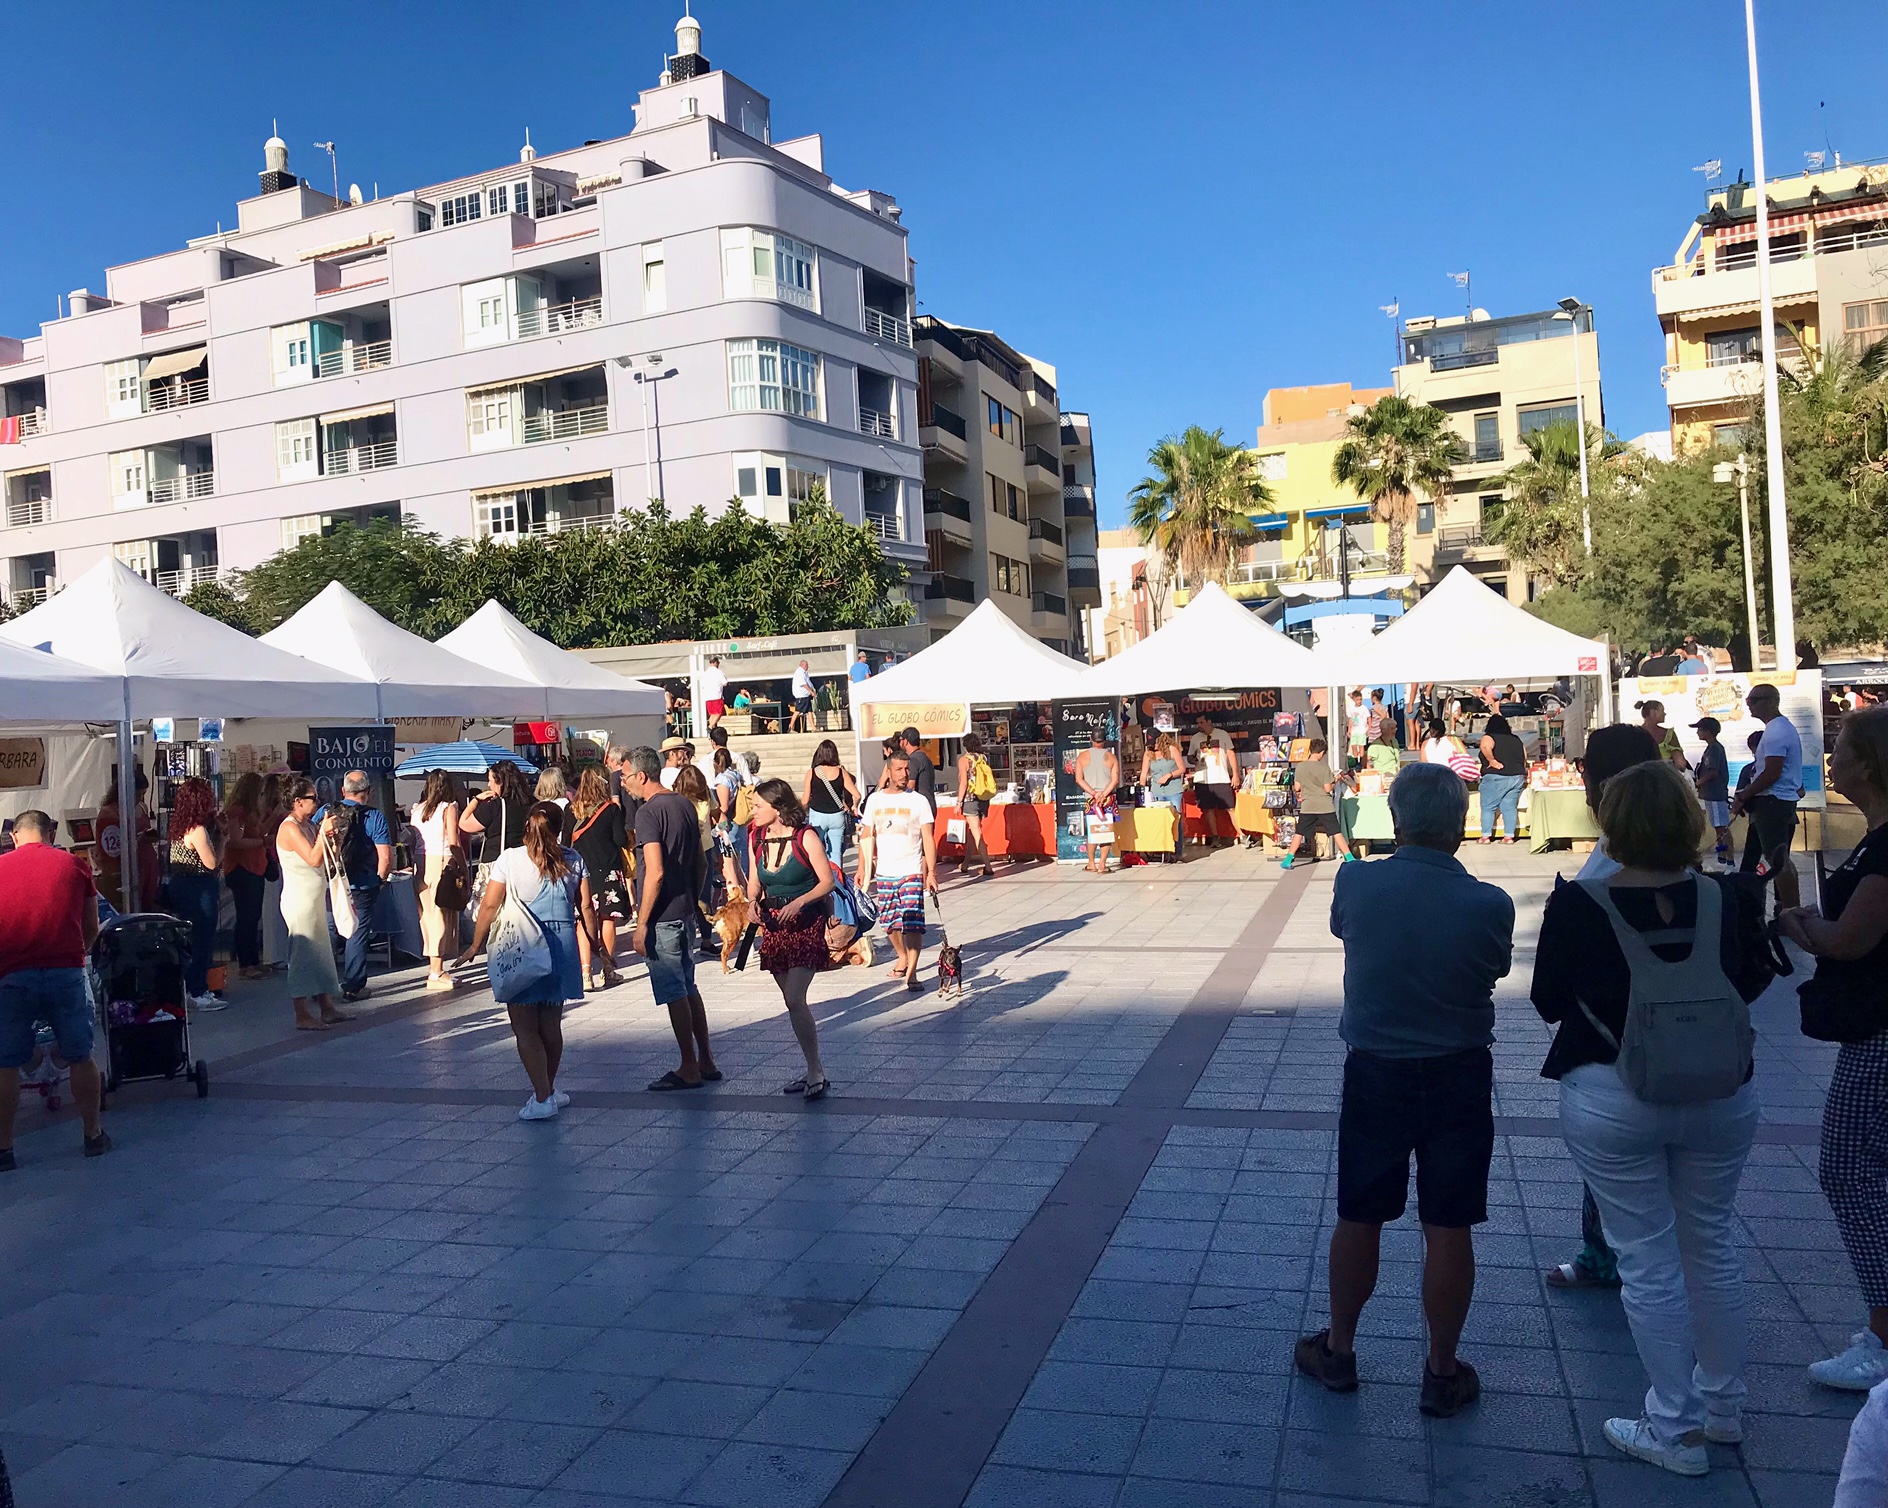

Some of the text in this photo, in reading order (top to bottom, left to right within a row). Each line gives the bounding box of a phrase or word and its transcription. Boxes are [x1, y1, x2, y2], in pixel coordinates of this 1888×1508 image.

[871, 713, 883, 725] EL
[888, 711, 920, 724] GLOBO
[924, 707, 961, 722] CÓMICS
[316, 736, 391, 757] BAJO EL
[314, 757, 392, 770] CONVENTO
